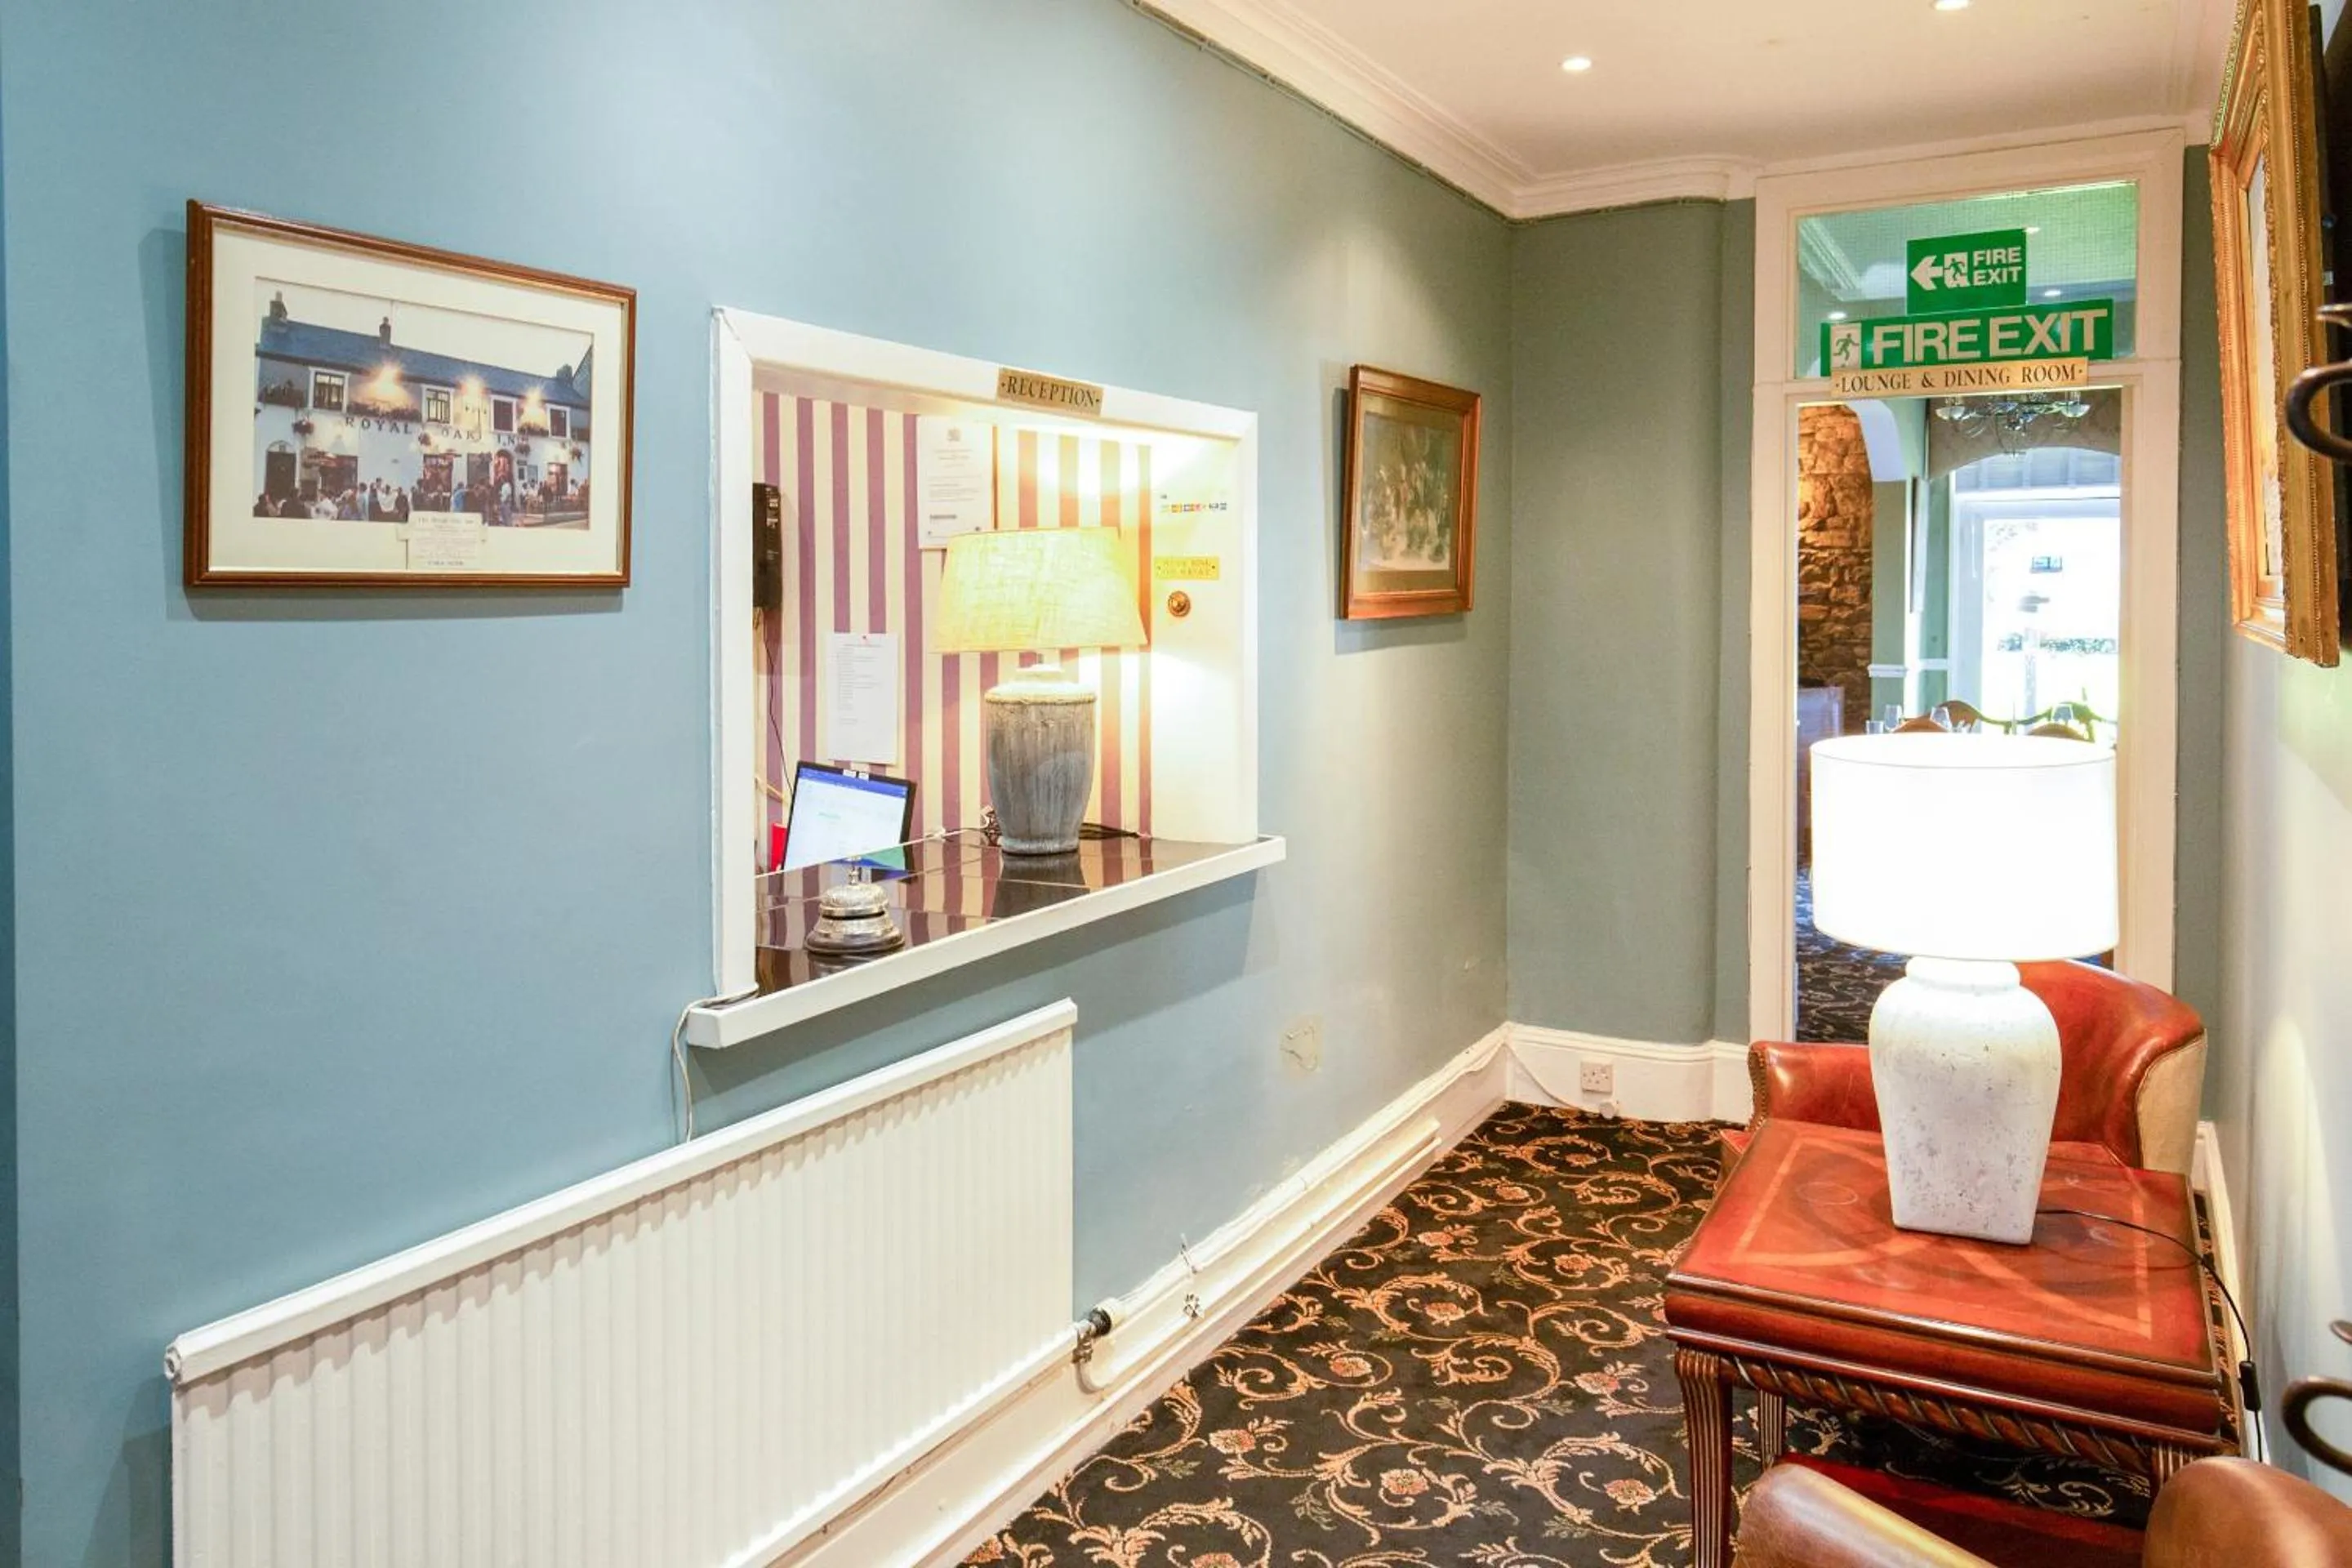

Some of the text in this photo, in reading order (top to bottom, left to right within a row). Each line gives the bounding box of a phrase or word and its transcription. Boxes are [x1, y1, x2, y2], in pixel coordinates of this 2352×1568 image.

[1973, 246, 2021, 267] FIRE
[1973, 266, 2022, 286] EXIT
[1873, 309, 2108, 364] FIRE EXIT
[1007, 376, 1096, 407] RECEPTION
[1842, 363, 2075, 393] LOUNGE & DINING ROOM
[345, 416, 412, 434] ROYAL
[441, 425, 476, 440] OAK
